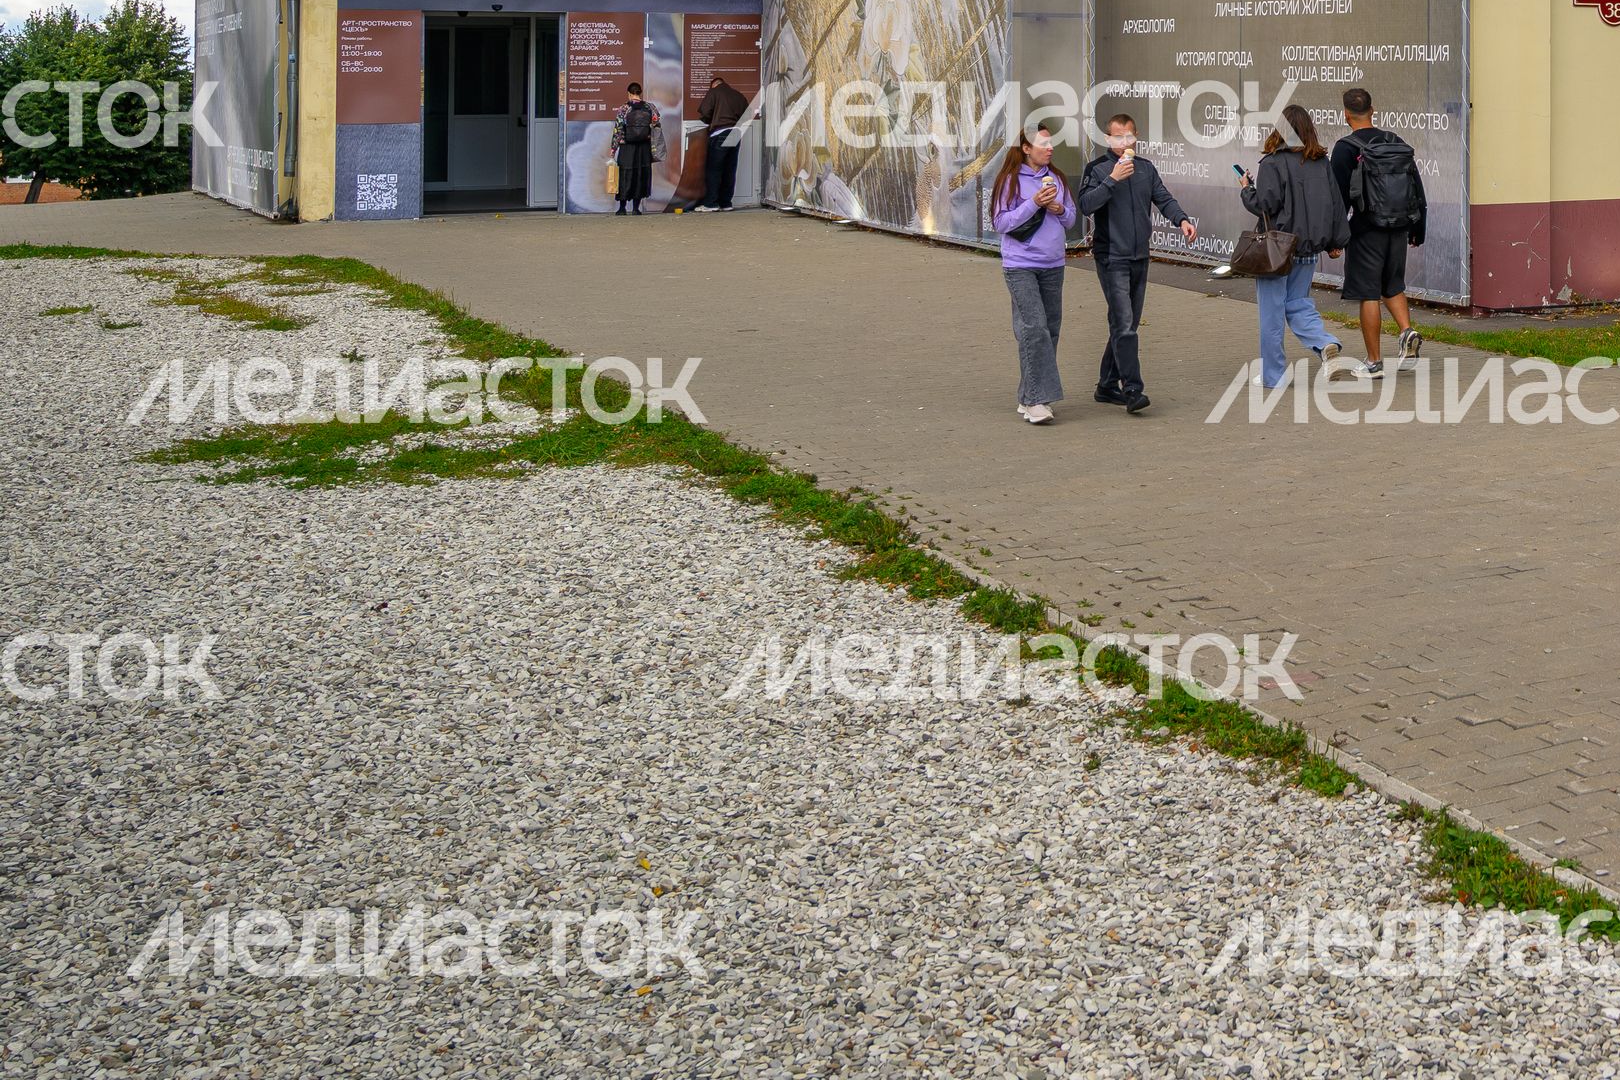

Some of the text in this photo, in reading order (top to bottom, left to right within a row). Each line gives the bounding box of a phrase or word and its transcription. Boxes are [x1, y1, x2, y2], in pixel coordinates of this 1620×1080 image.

[1214, 0, 1252, 18] ЛИЧНЫЕ
[1122, 18, 1175, 34] АРХЕОЛОГИЯ
[1176, 49, 1253, 68] ИСТОРИЯ ГОРОДА
[1281, 45, 1450, 64] КОЛЛЕКТИВНАЯ ИНСТАЛЛЯЦИЯ
[1281, 63, 1364, 85] «ДУША ВЕЩЕЙ»
[1105, 81, 1186, 99] «КРАСНЫЙ ВОСТОК»
[1205, 105, 1237, 122] СЛЕДЫ
[1380, 111, 1449, 131] ИСКУССТВО
[1202, 123, 1237, 141] ДРУГИХ
[1136, 141, 1185, 158] ПРИРОДНОЕ
[1151, 231, 1187, 248] ОБМЕНА
